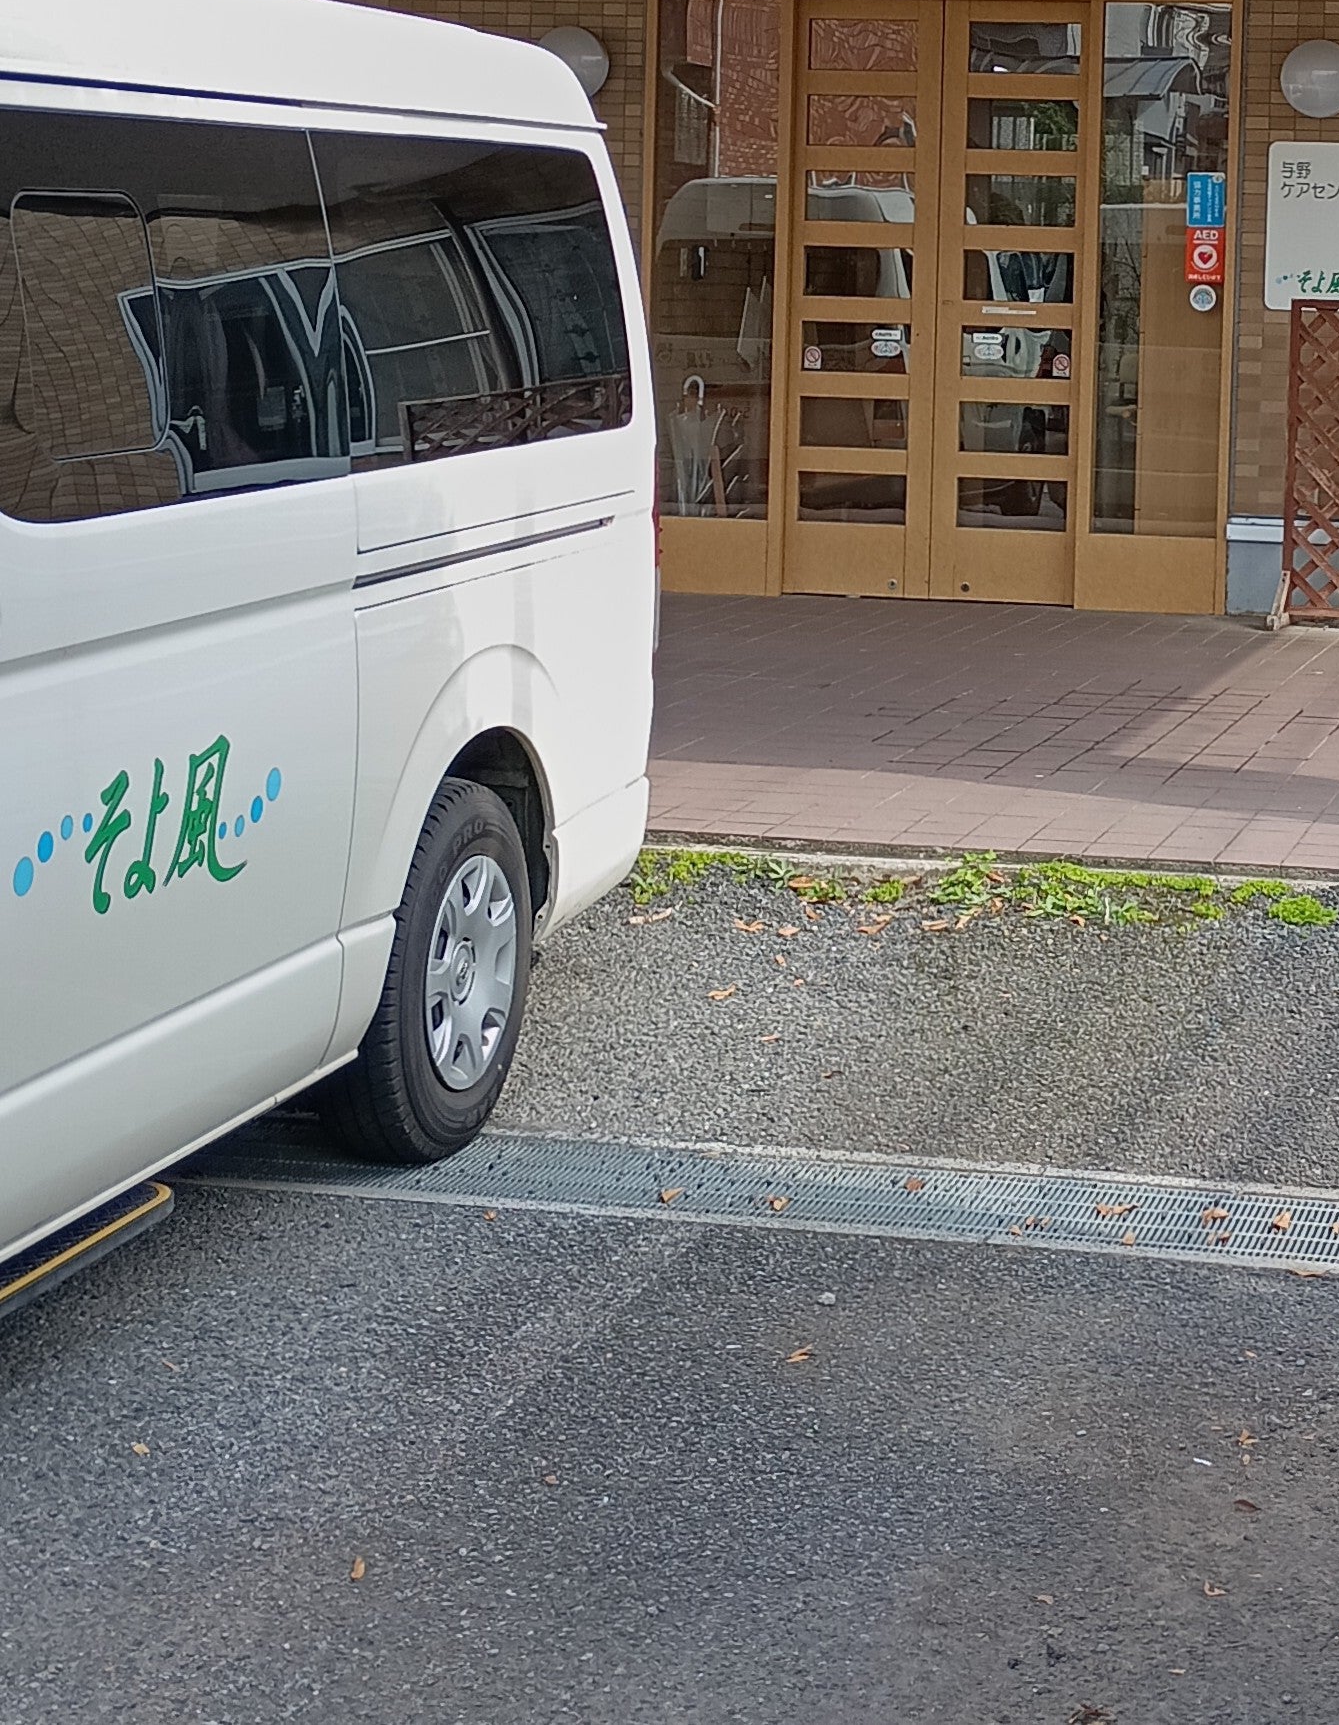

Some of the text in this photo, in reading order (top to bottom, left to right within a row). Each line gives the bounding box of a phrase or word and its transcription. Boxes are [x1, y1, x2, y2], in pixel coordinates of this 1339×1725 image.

[1281, 161, 1311, 179] 与野
[1194, 230, 1219, 240] AED
[84, 734, 248, 915] そよ風
[452, 818, 485, 856] PRO
